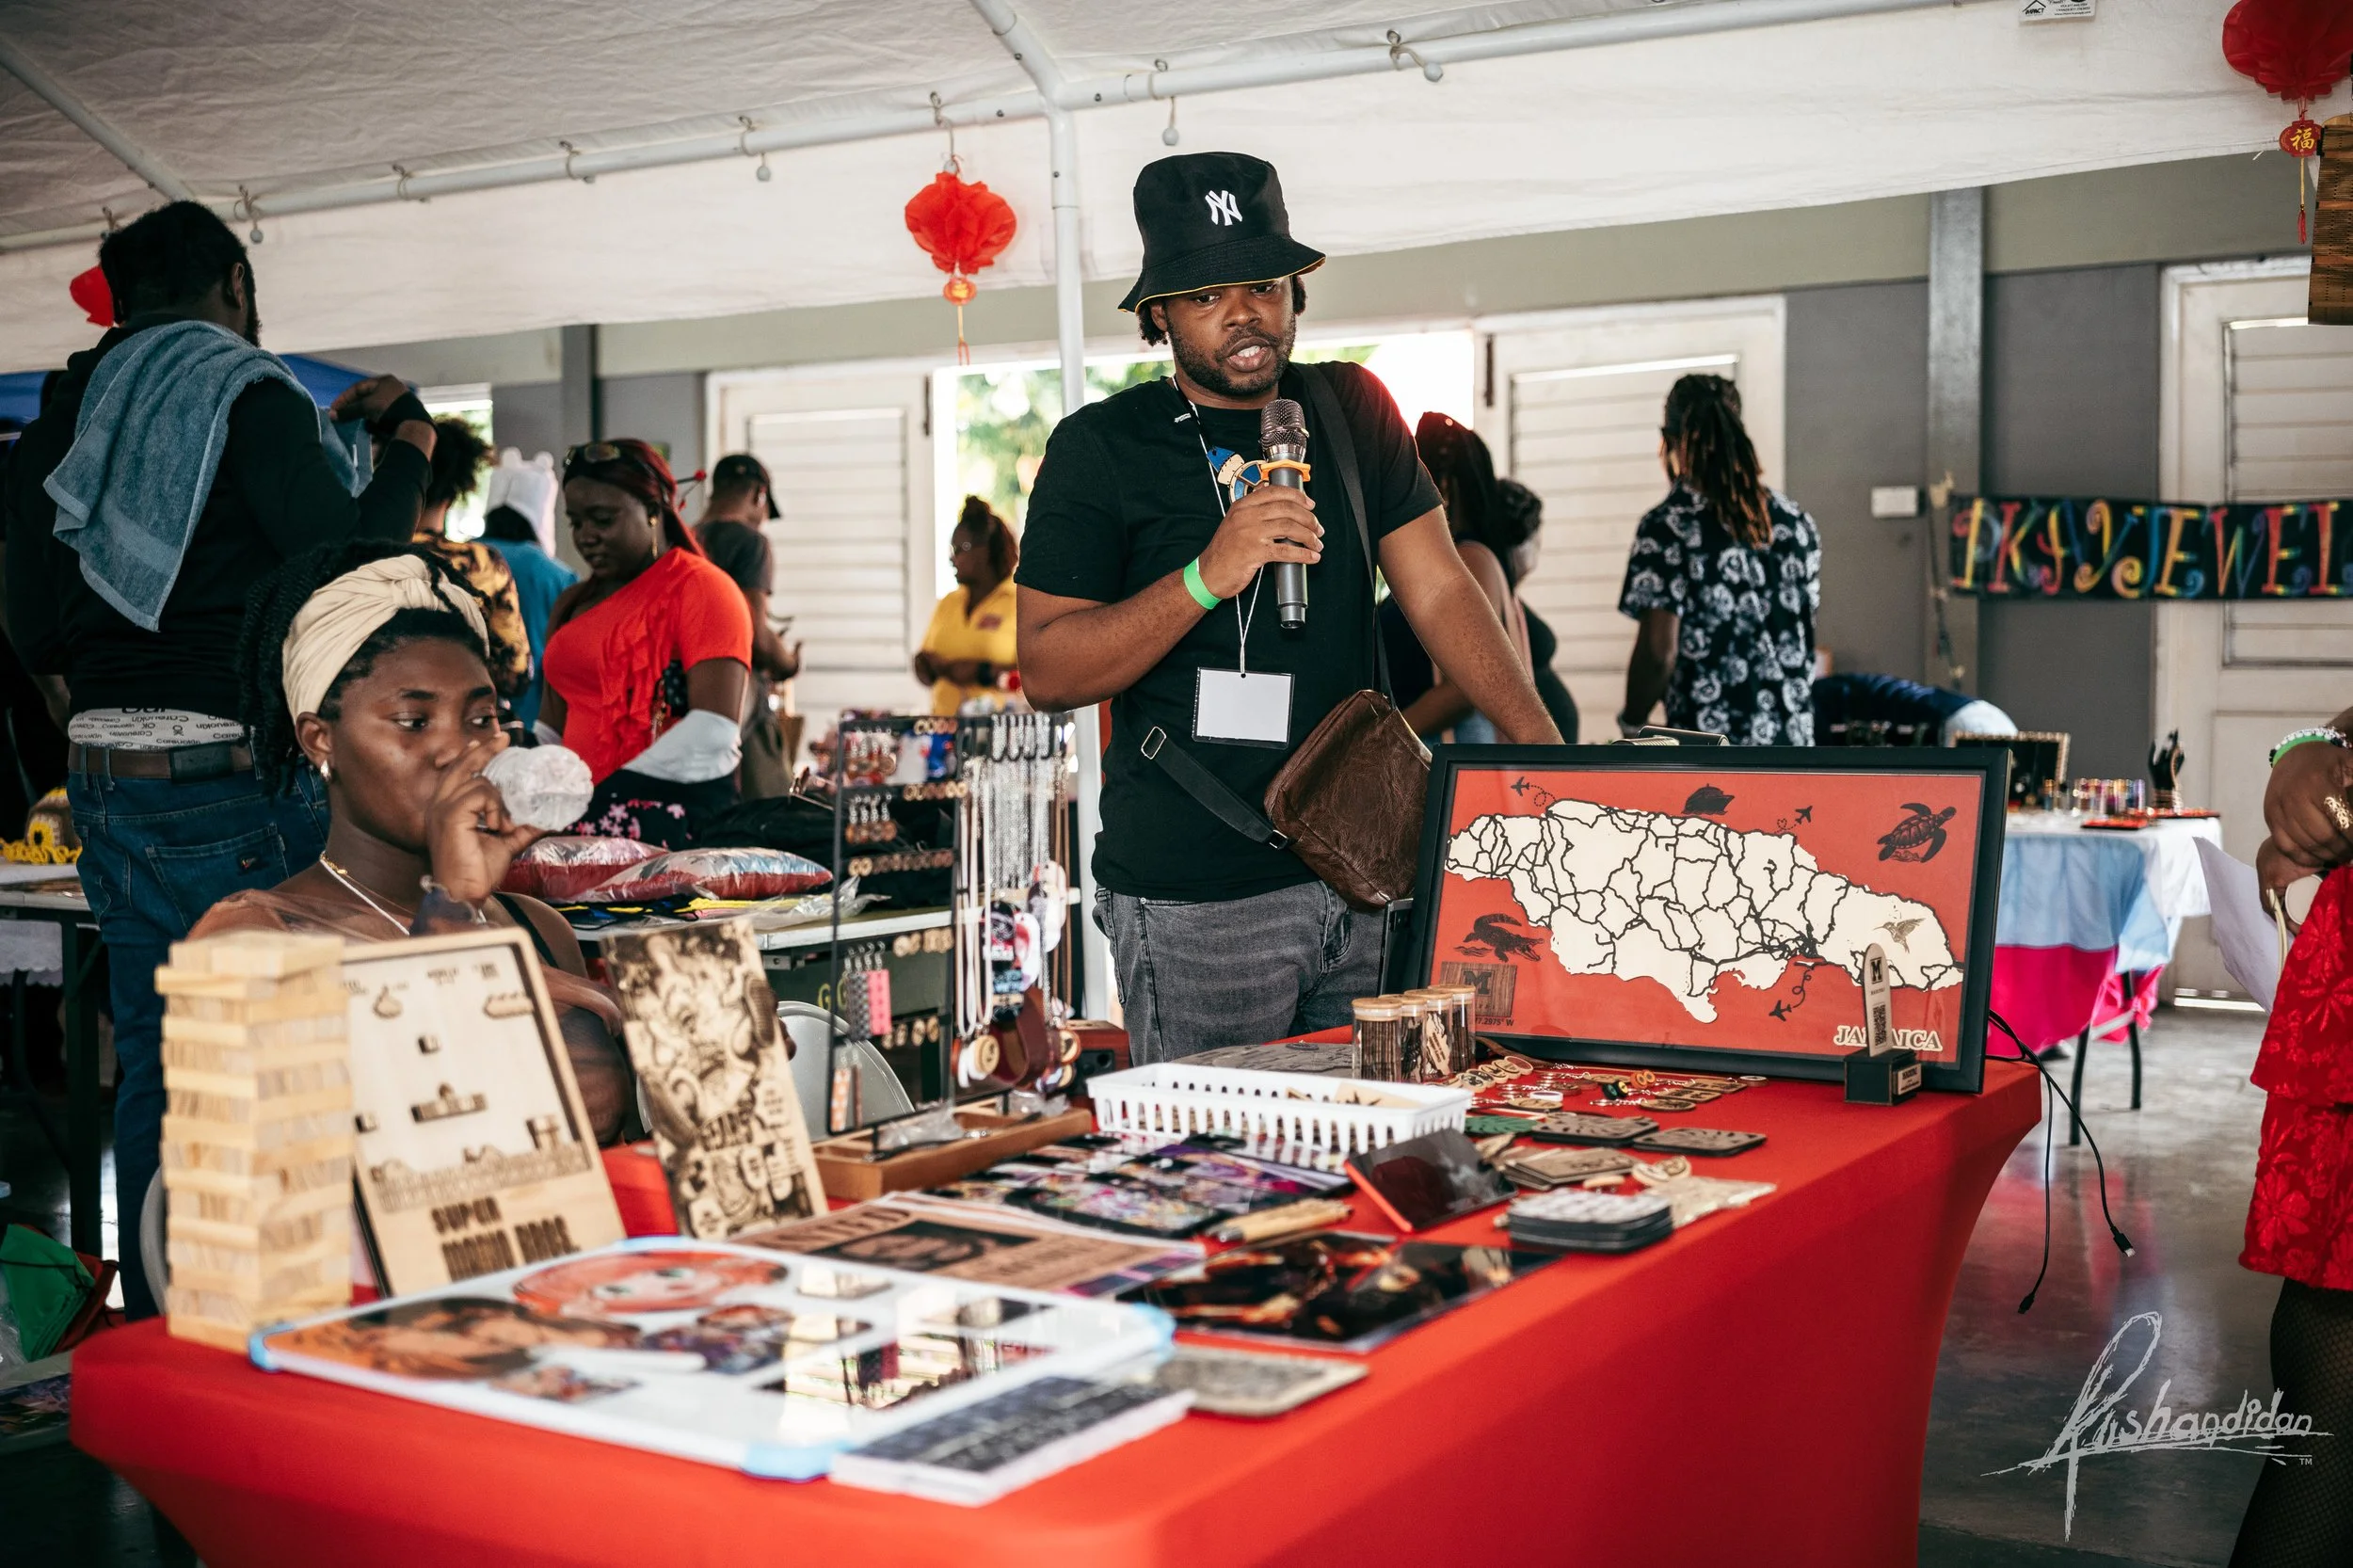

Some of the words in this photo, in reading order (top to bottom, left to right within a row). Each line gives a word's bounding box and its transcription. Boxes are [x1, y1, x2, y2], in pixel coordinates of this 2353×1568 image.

[2290, 128, 2314, 151] 福
[1205, 190, 1242, 226] NY
[1870, 958, 1882, 983] M
[1465, 971, 1492, 994] M
[1505, 1018, 1514, 1027] W
